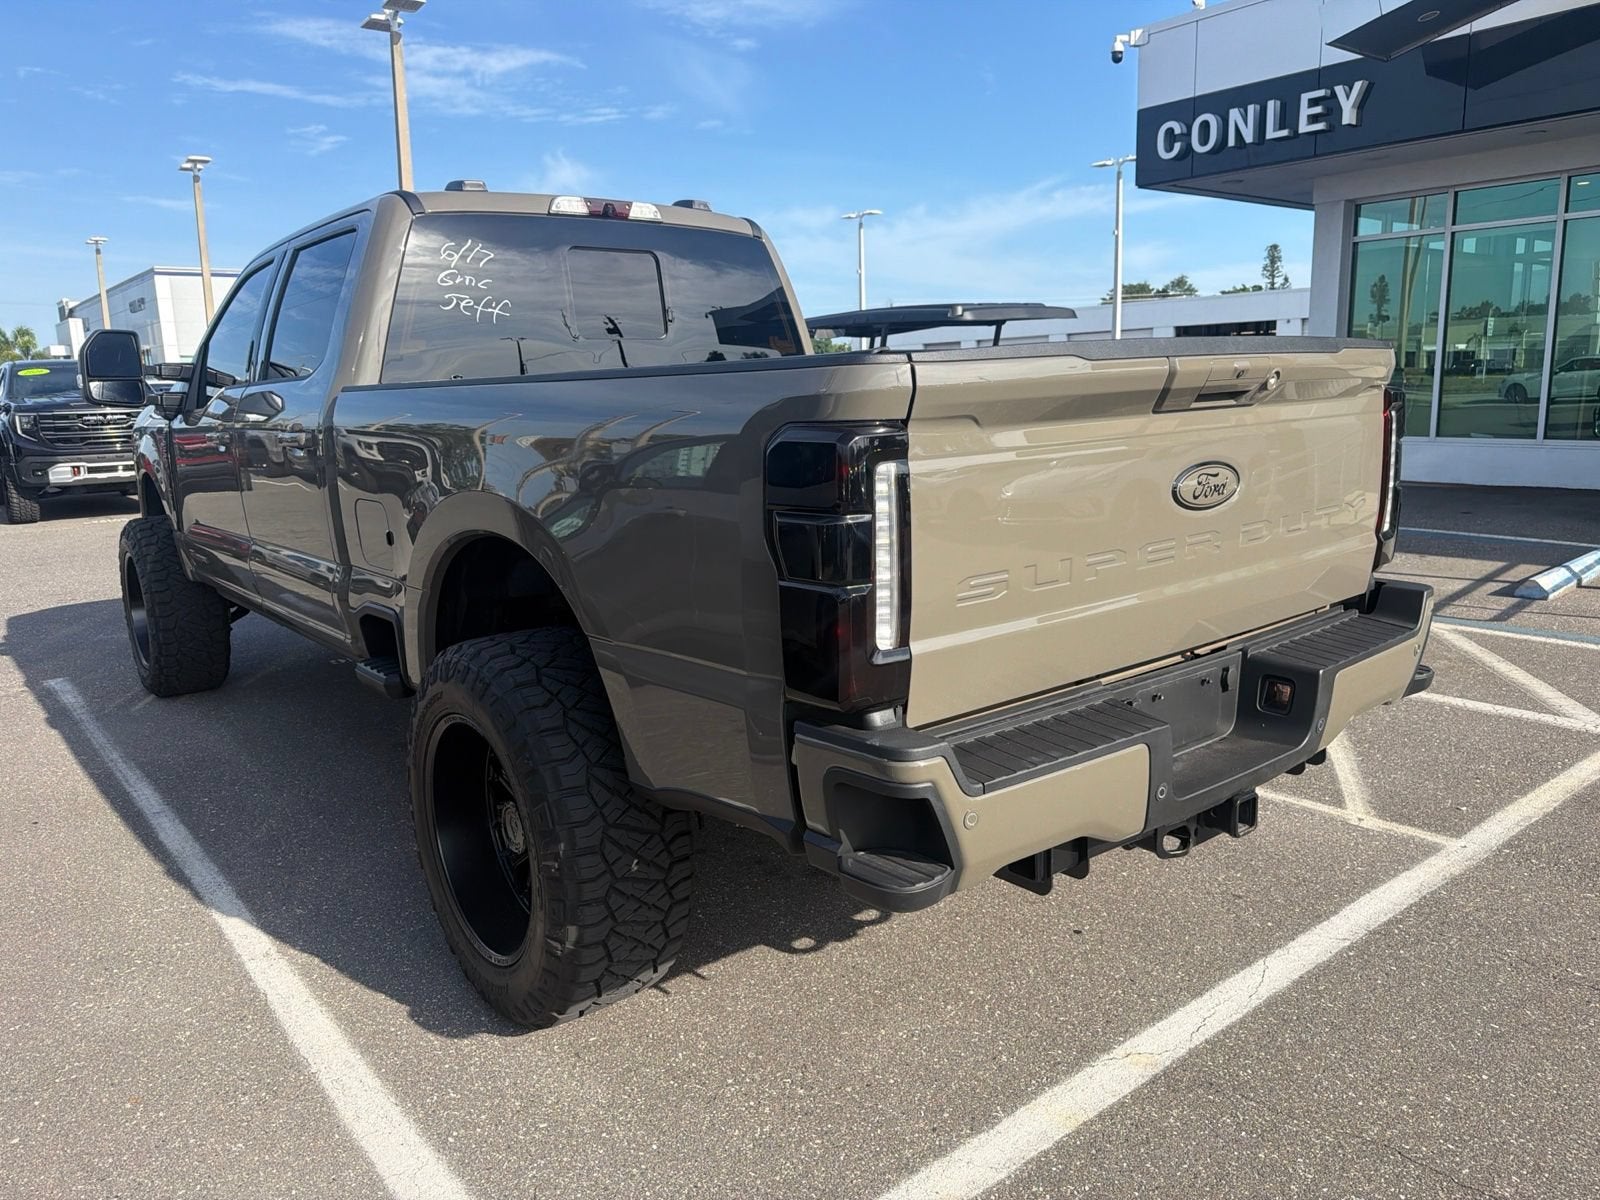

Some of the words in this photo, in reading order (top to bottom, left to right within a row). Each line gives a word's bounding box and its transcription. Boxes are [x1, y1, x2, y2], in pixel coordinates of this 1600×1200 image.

[1156, 79, 1370, 161] CONLEY
[440, 239, 495, 268] 6/17
[440, 293, 512, 324] Jeff
[82, 414, 128, 425] GMC
[1192, 471, 1229, 500] Ford
[956, 529, 1222, 607] SUPER
[1238, 489, 1368, 548] DUTY
